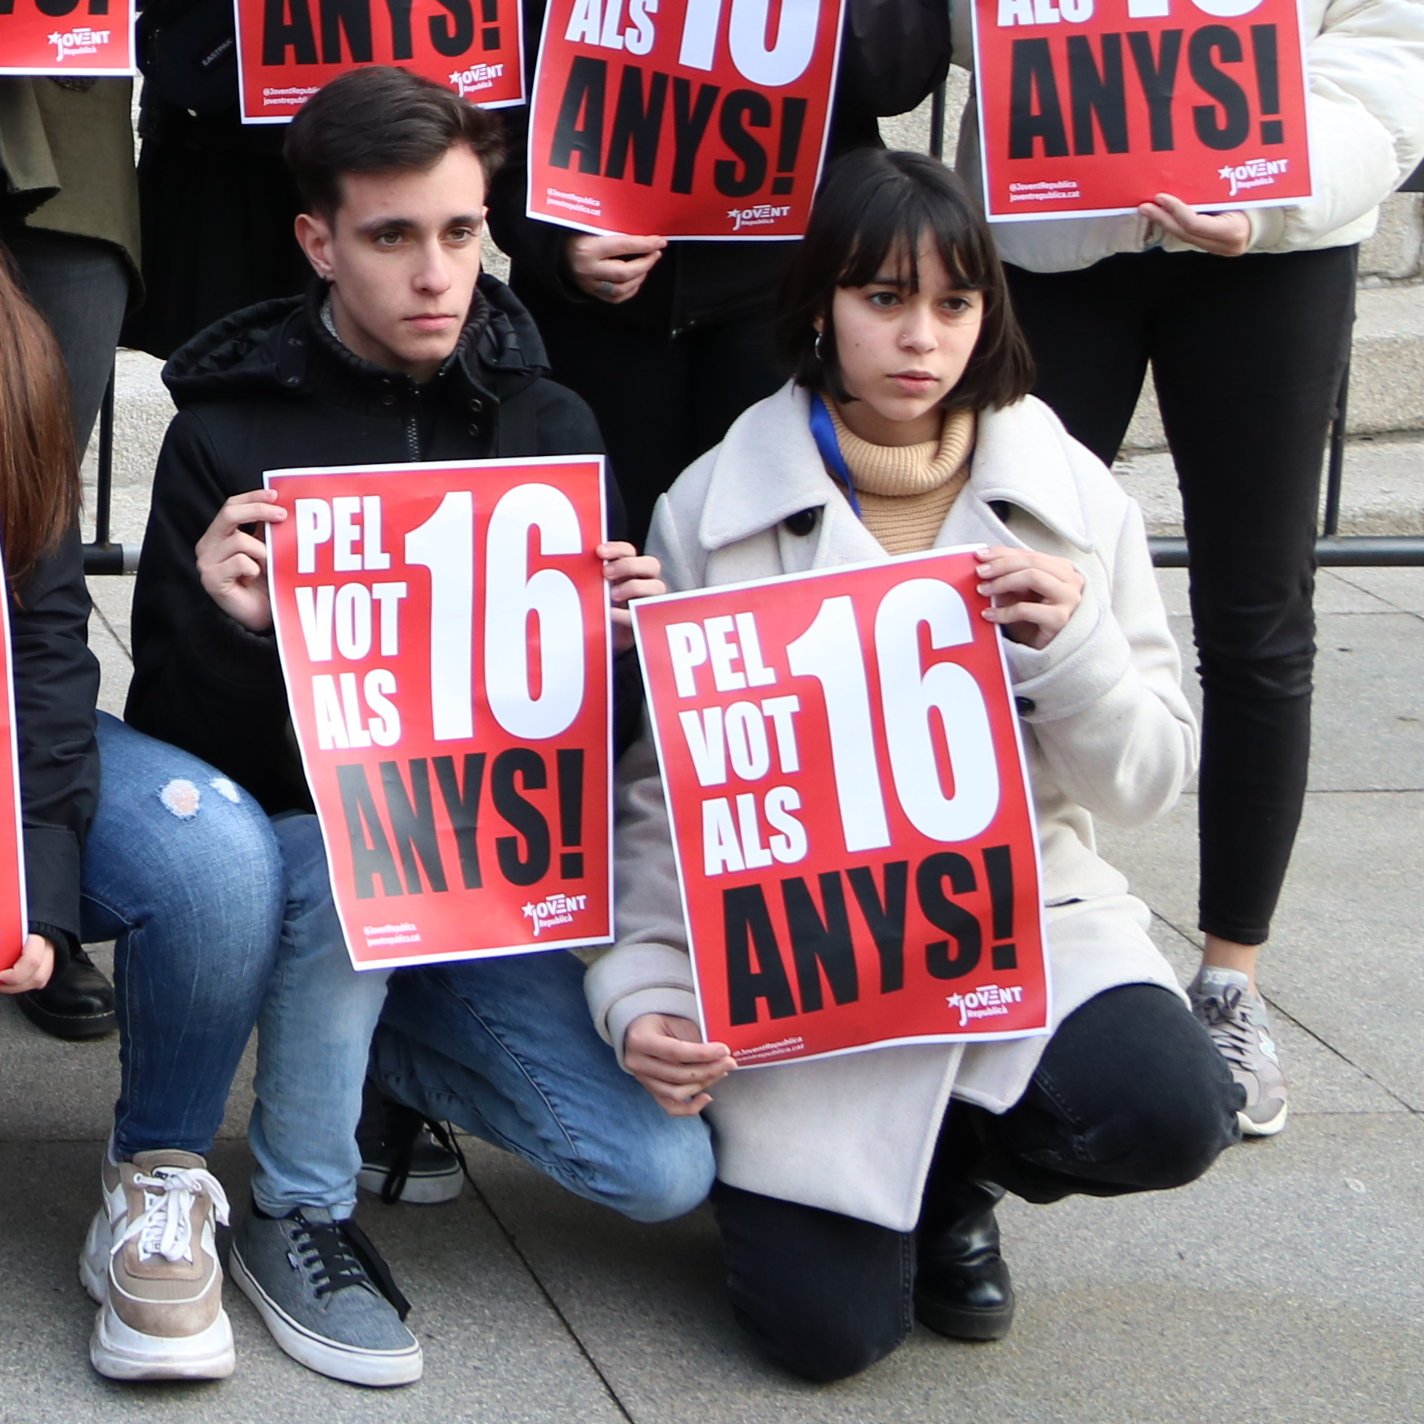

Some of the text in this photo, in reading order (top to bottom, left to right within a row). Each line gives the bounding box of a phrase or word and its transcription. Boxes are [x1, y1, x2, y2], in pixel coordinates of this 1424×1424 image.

[56, 28, 110, 62] JOVENT
[458, 63, 504, 98] JOVENT
[548, 55, 808, 199] ANYS!
[1008, 23, 1284, 160] ANYS!
[734, 205, 790, 231] JOVENT
[1229, 157, 1288, 196] JOVENT
[294, 494, 390, 574] PEL
[294, 581, 407, 663] VOT
[404, 483, 585, 742] 16
[665, 611, 777, 698] PEL
[312, 668, 401, 750] ALS
[678, 694, 801, 788] VOT
[785, 577, 1001, 854] 16
[335, 747, 585, 900] ANYS!
[701, 785, 808, 877] ALS
[532, 894, 587, 936] JOVENT
[722, 844, 1017, 1027] ANYS!
[958, 985, 1022, 1026] JOVENT
